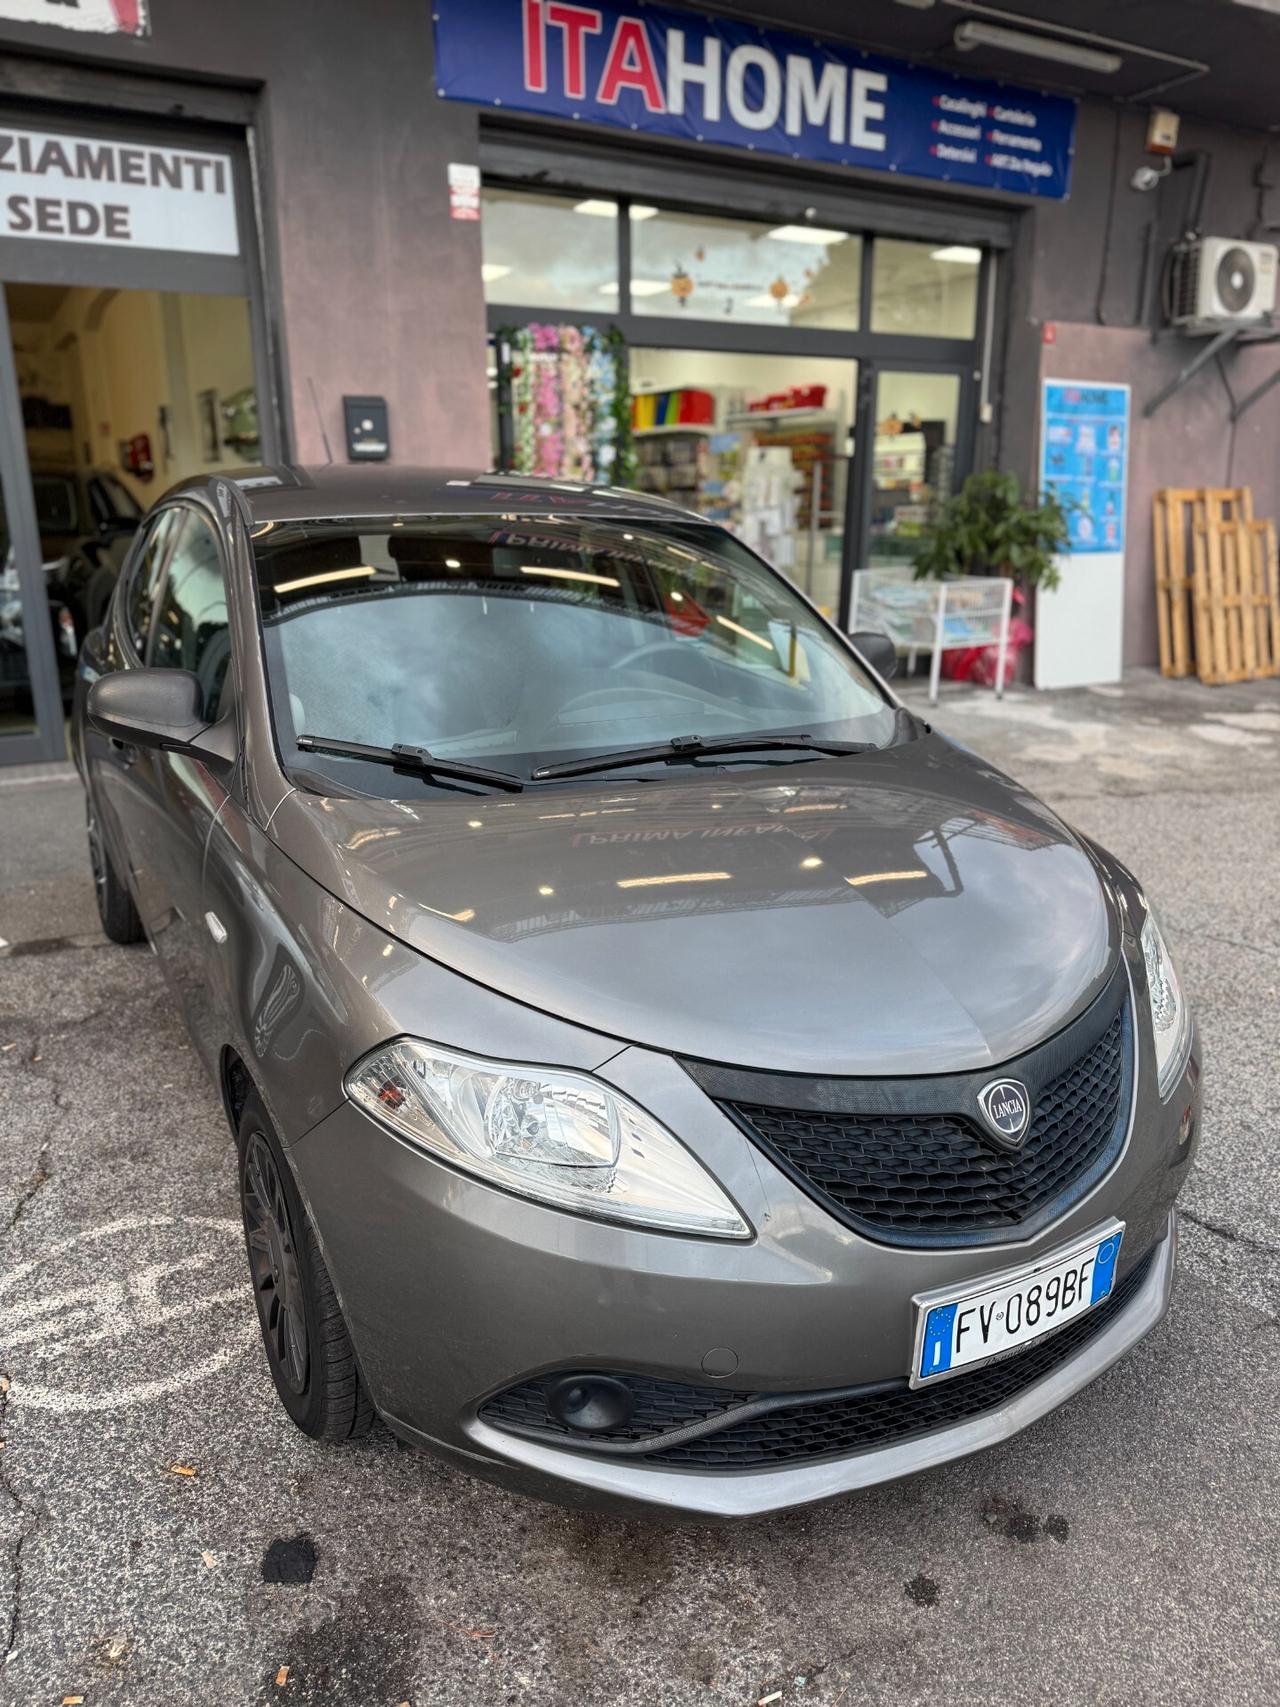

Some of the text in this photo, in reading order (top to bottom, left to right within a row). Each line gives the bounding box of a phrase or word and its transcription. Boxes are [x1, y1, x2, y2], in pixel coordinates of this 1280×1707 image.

[522, 0, 888, 151] ITAHOME
[7, 194, 132, 240] SEDE
[992, 1098, 1023, 1119] LANCIA
